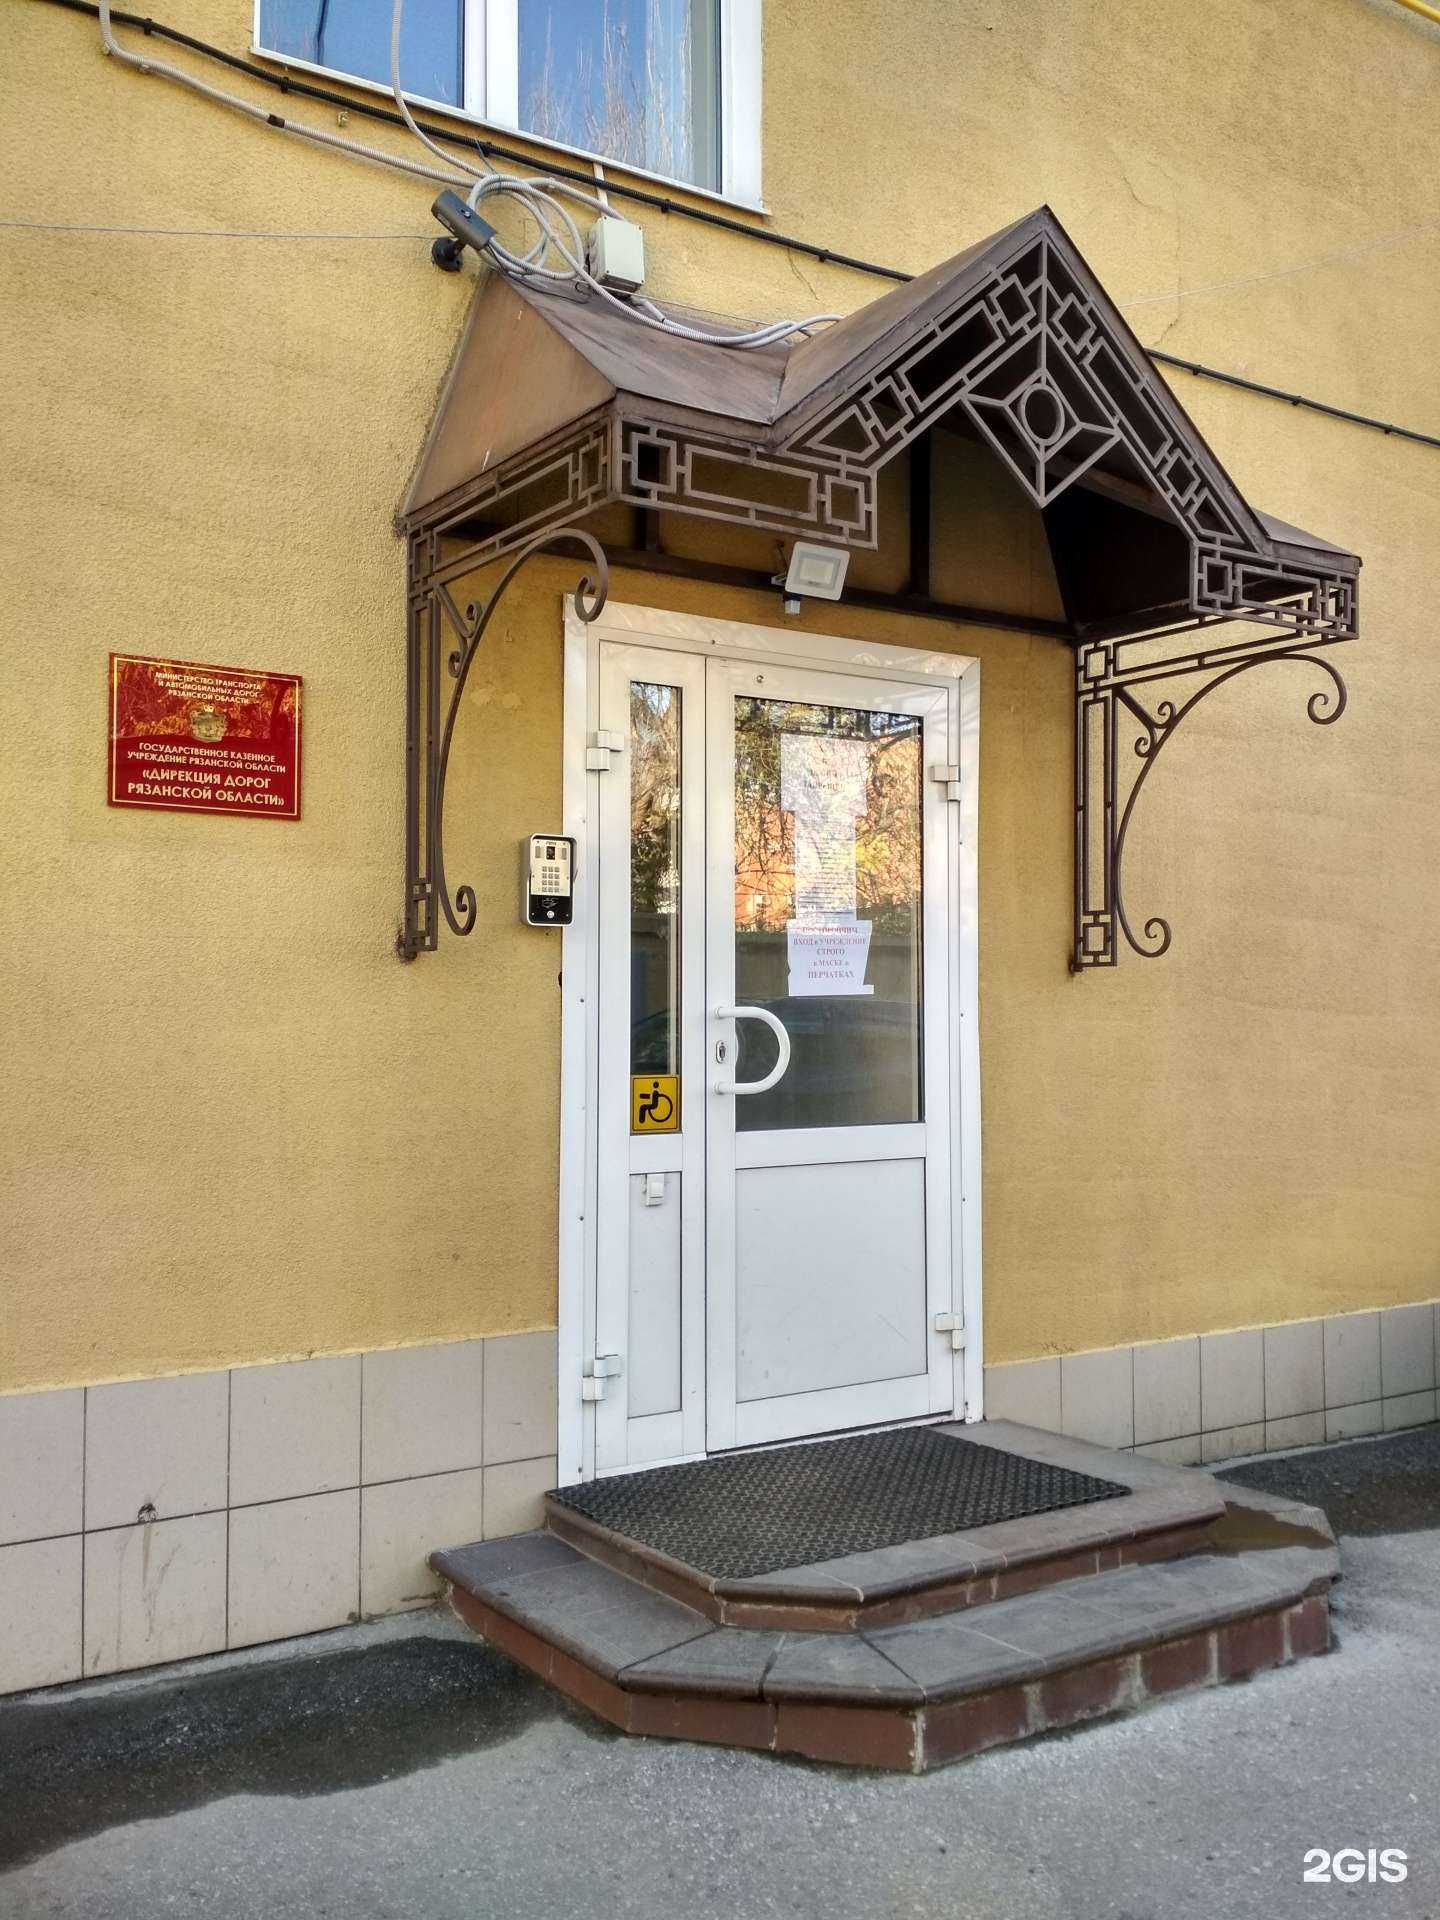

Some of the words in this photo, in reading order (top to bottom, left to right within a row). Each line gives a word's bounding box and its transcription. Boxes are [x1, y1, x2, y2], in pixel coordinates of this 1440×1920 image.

[155, 672, 213, 685] МИНИСТЕРСТВО
[215, 678, 261, 690] ТРАНСПОРТА
[166, 681, 231, 695] АВТОМОБИЛЬНЫХ
[233, 689, 259, 698] ДОРОГ
[168, 690, 213, 700] РЯЗАНСКОЙ
[215, 694, 249, 704] ОБЛАСТИ
[128, 751, 186, 764] УЧРЕЖДЕНИЕ
[189, 757, 242, 769] РЯЗАНСКОЙ
[245, 763, 286, 773] ОБЛАСТИ
[139, 742, 229, 758] ГОСУДАРСТВЕННОЕ
[230, 751, 276, 763] КАЗЕННОЕ
[143, 768, 221, 785] «ДИРЕКЦИЯ
[224, 776, 271, 789] ДОРОГ
[128, 783, 211, 800] РЯЗАНСКОЙ
[215, 791, 284, 806] ОБЛАСТИ»
[808, 970, 855, 978] ПЕРЧАТКАХ
